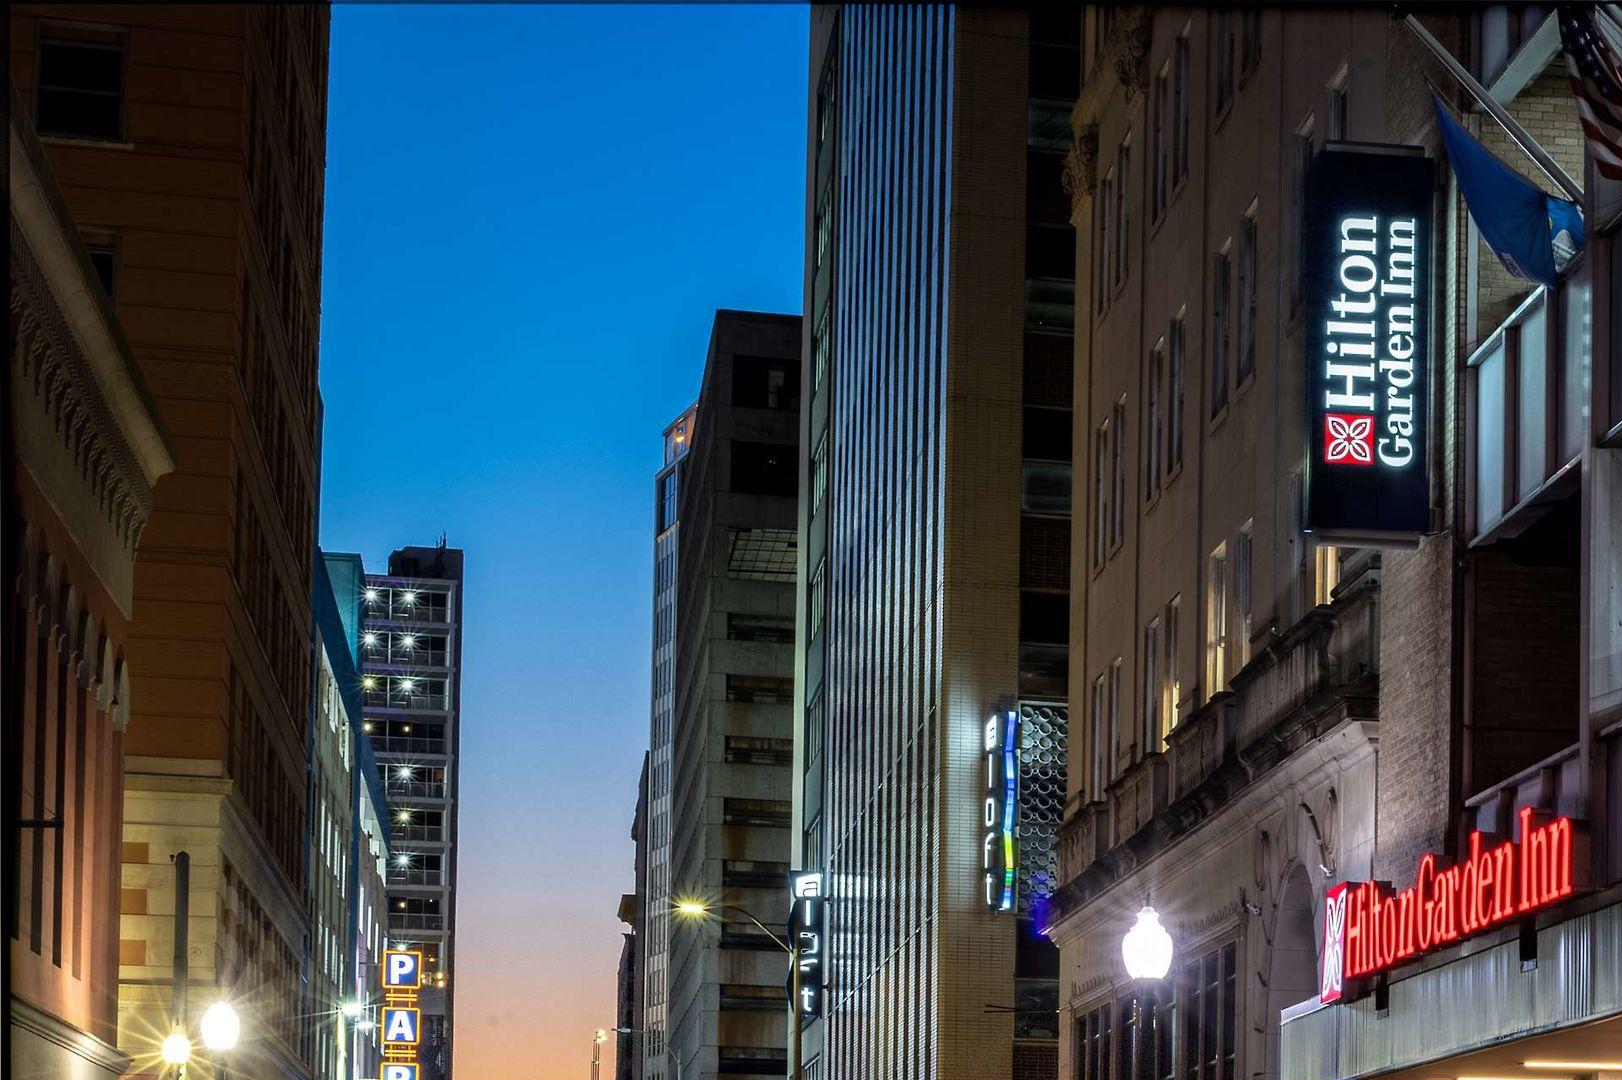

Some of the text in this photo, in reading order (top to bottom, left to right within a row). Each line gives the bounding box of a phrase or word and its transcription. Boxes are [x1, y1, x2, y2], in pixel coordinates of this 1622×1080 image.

[1326, 215, 1378, 411] Hilton
[1378, 218, 1416, 467] Garden Inn
[1345, 806, 1573, 978] Hilton Garden Inn
